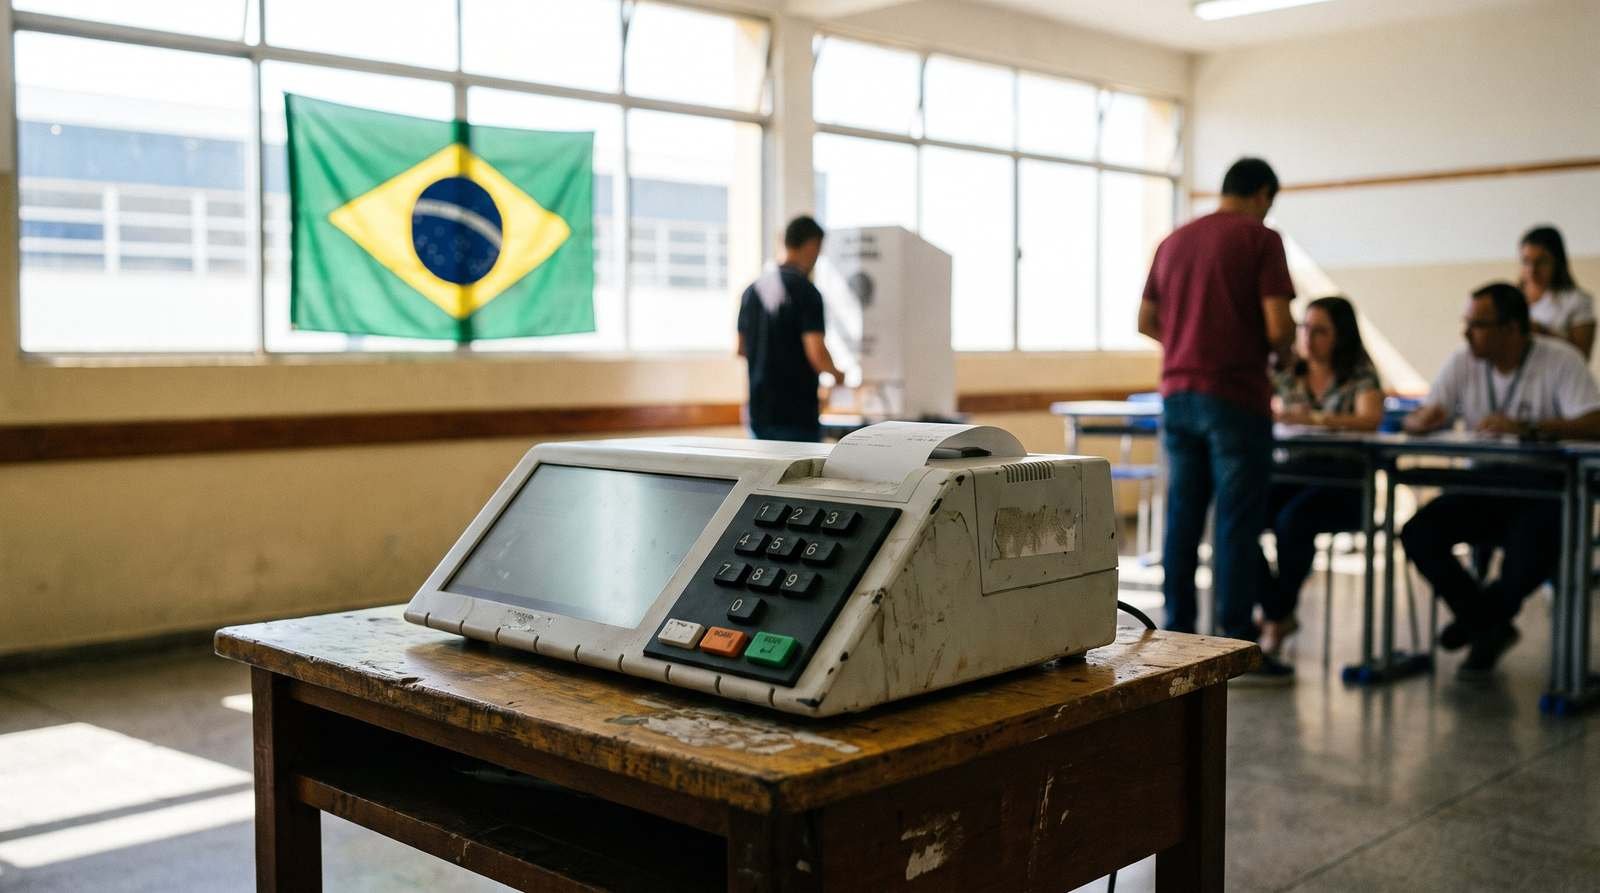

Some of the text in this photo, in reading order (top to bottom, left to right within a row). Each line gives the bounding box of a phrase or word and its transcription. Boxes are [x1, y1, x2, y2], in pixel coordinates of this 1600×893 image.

[760, 505, 838, 524] 1 2 3
[739, 534, 818, 555] 4 5 6
[719, 563, 798, 587] 7 8 9
[731, 599, 743, 612] 0
